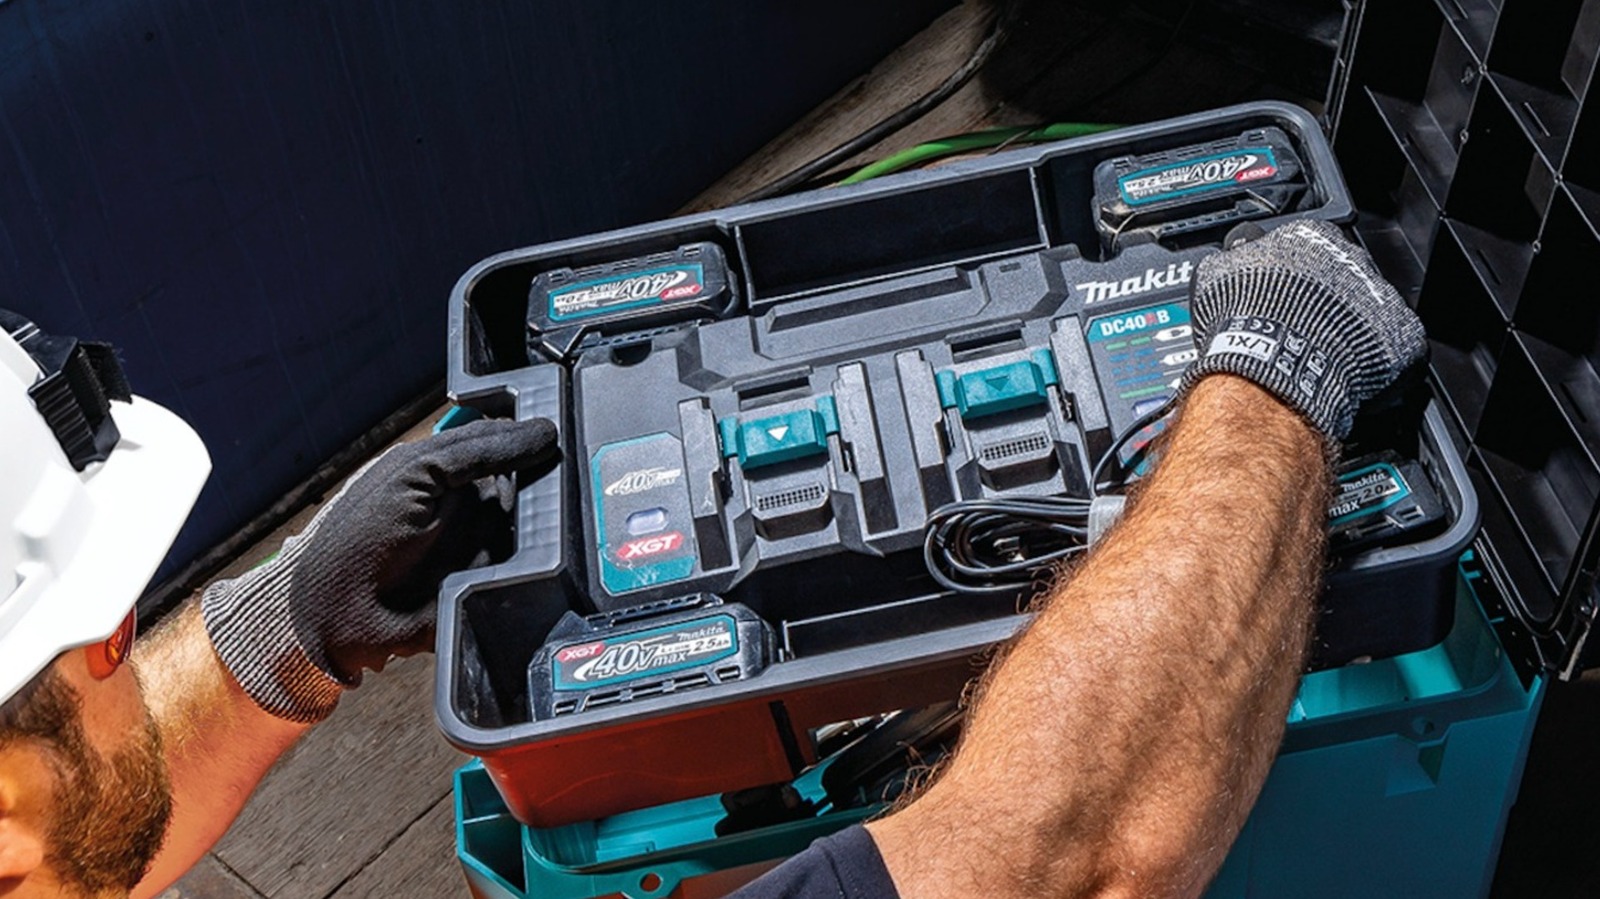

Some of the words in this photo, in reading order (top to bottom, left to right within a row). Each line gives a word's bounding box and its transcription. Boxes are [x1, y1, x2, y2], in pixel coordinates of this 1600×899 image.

[1240, 167, 1271, 180] XGT
[665, 285, 697, 298] XGT
[1076, 261, 1194, 304] makit
[1226, 334, 1271, 353] L/XL
[1341, 473, 1387, 492] makita
[1328, 499, 1361, 518] max
[626, 535, 677, 559] XGT
[677, 625, 724, 641] makita
[564, 645, 599, 662] XGT
[651, 651, 687, 668] max
